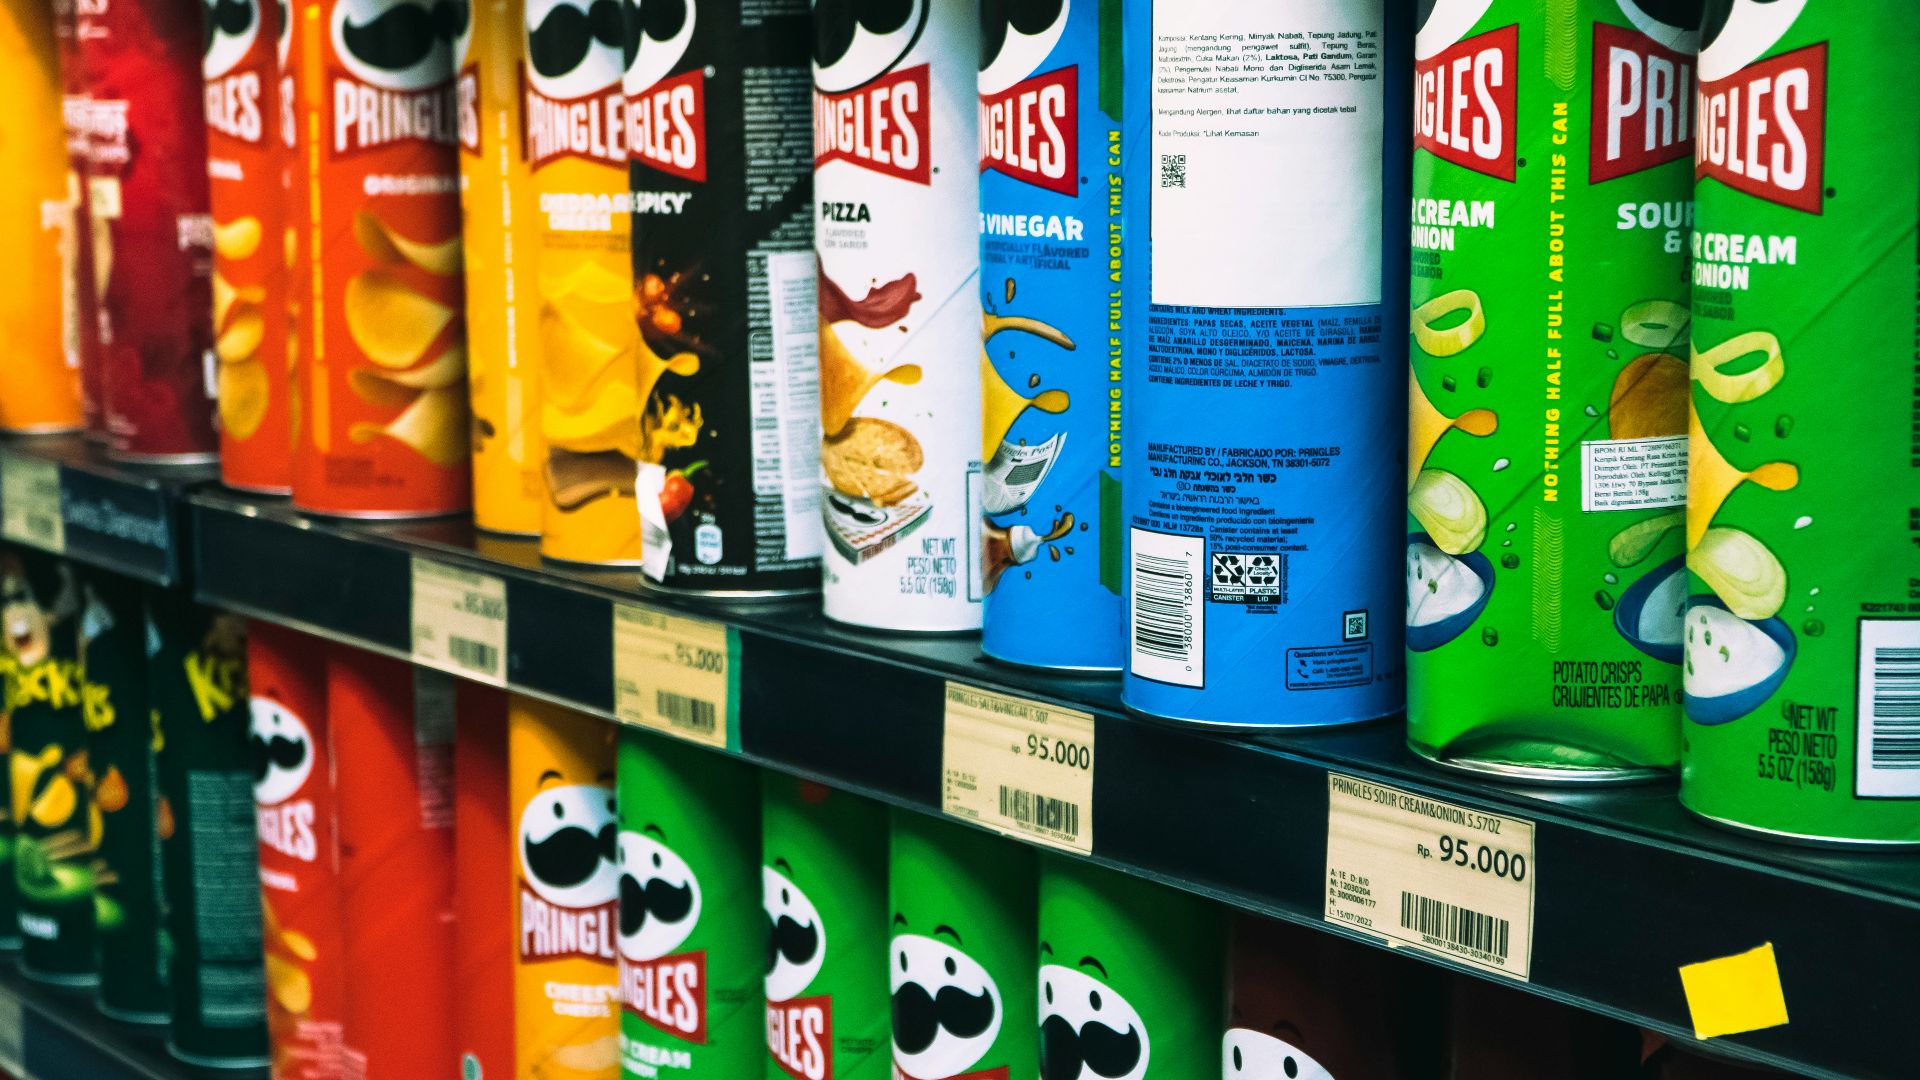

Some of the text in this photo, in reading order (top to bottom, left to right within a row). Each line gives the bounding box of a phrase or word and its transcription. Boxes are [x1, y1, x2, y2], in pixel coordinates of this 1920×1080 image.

[1308, 32, 1335, 40] Tepung
[1322, 42, 1348, 50] Tepung
[1266, 54, 1300, 62] Laktosa,
[1313, 106, 1338, 114] dicetak
[822, 202, 871, 223] PIZZA
[1418, 198, 1495, 230] CREAM
[986, 214, 1084, 241] VINEGAR
[1411, 226, 1455, 251] ONION
[1664, 230, 1682, 254] &
[1704, 233, 1798, 265] CREAM
[1695, 263, 1750, 291] ONION
[1108, 130, 1122, 468] NOTHING HALF FULL ABOUT THIS CAN
[1543, 102, 1568, 502] NOTHING HALF FULL ABOUT THIS CAN
[1194, 320, 1314, 328] PAPAS ACEITE VEGETAL
[1174, 337, 1206, 346] AMARILLO
[1190, 358, 1212, 366] MENOS
[1235, 380, 1258, 388] LECHE
[1148, 442, 1341, 458] MANUFACTURED BY FABRICADO POR: PRINGLES
[1594, 446, 1616, 454] BPOM
[1148, 452, 1330, 469] MANUFACTURING CO., JACKSON, TN 38301-5072
[1257, 473, 1277, 484] כשר
[1148, 500, 1276, 516] Contains bioengineered food ingredient
[1148, 509, 1171, 519] Contiene
[1180, 513, 1215, 524] ingrediente
[1216, 515, 1252, 524] producido
[1210, 526, 1238, 534] Canister
[1280, 526, 1298, 534] least
[1210, 534, 1224, 542] 50%
[1226, 535, 1256, 544] recycled
[922, 538, 956, 555] NET WT
[1226, 544, 1278, 552] post-consumer
[908, 557, 956, 576] PESO NETO
[900, 577, 957, 598] 5.5 OZ (158g)
[1184, 573, 1193, 608] 13860
[1214, 594, 1244, 602] CANISTER
[1184, 614, 1192, 650] 38000
[1553, 661, 1642, 684] POTATO CRISPS
[1553, 684, 1670, 708] CRUJIENTES DE PAPA
[1790, 704, 1838, 733] NET WT
[1027, 734, 1090, 770] 95.000
[1768, 728, 1838, 760] PESO NETO
[1758, 754, 1837, 792] 5.5 OZ (158g)
[1332, 778, 1501, 835] PRINGLES SOUR CREAM&ONION 5.57OZ
[1417, 834, 1526, 882] Rp. 95.000
[1330, 868, 1358, 882] A: 1E D:
[1330, 878, 1371, 897] M: 12030204
[1330, 888, 1376, 908] R: 3000006177
[1330, 898, 1336, 907] H:
[1336, 908, 1372, 928] 15/07/2022
